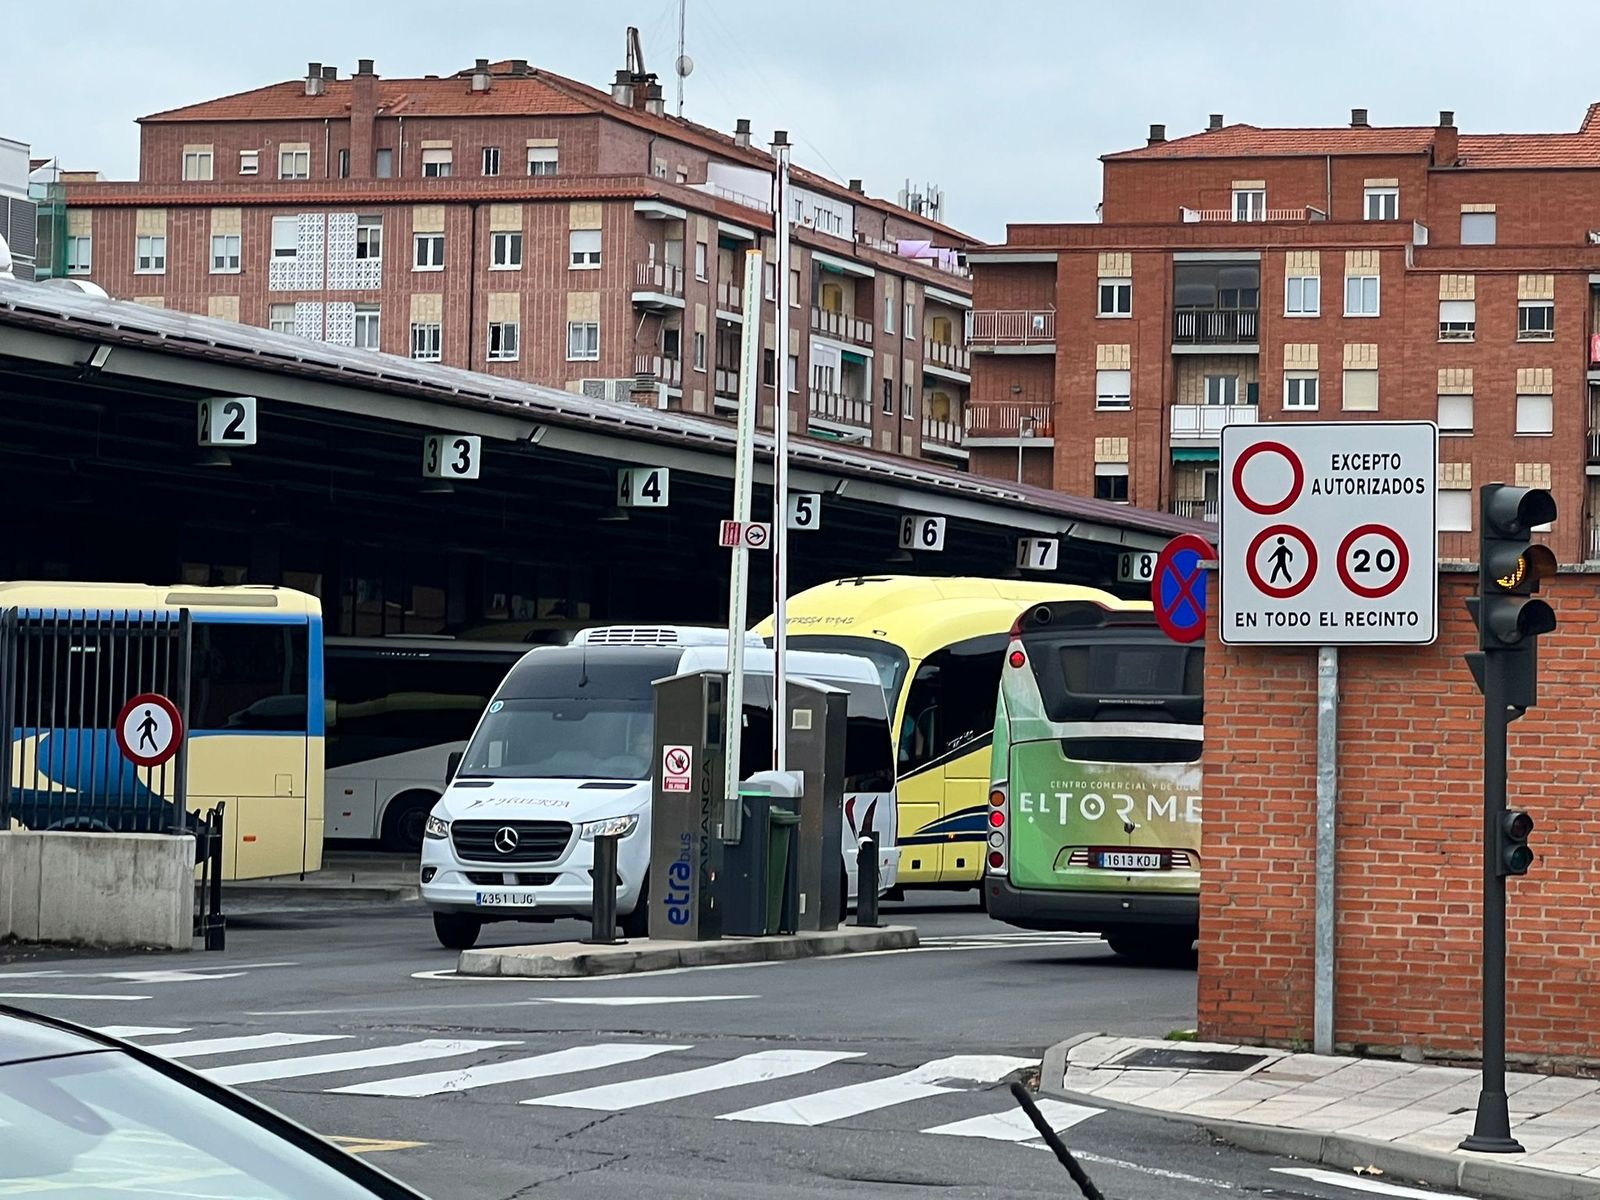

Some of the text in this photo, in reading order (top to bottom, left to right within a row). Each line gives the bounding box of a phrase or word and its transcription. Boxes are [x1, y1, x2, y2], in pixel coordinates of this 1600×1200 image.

[201, 403, 209, 442] 2
[223, 401, 246, 440] 2
[427, 438, 438, 473] 3
[451, 439, 471, 475] 3
[1331, 453, 1402, 471] EXCEPTO
[620, 471, 630, 503] 4
[641, 471, 662, 503] 4
[1311, 477, 1426, 496] AUTORIZADOS
[795, 496, 813, 526] 5
[903, 517, 913, 546] 6
[922, 519, 938, 547] 6
[1019, 540, 1029, 566] 7
[1037, 541, 1052, 566] 7
[1352, 548, 1396, 573] 20
[1121, 554, 1130, 579] 8
[1139, 555, 1153, 579] 8
[1235, 611, 1420, 628] EN TODO EL RECINTO
[1050, 780, 1087, 789] CENTRO
[1090, 780, 1148, 790] COMERCIAL
[1151, 782, 1158, 790] Y
[1019, 792, 1051, 813] EL
[1106, 854, 1159, 868] 1613 KDJ
[481, 893, 533, 905] 4351 LJG
